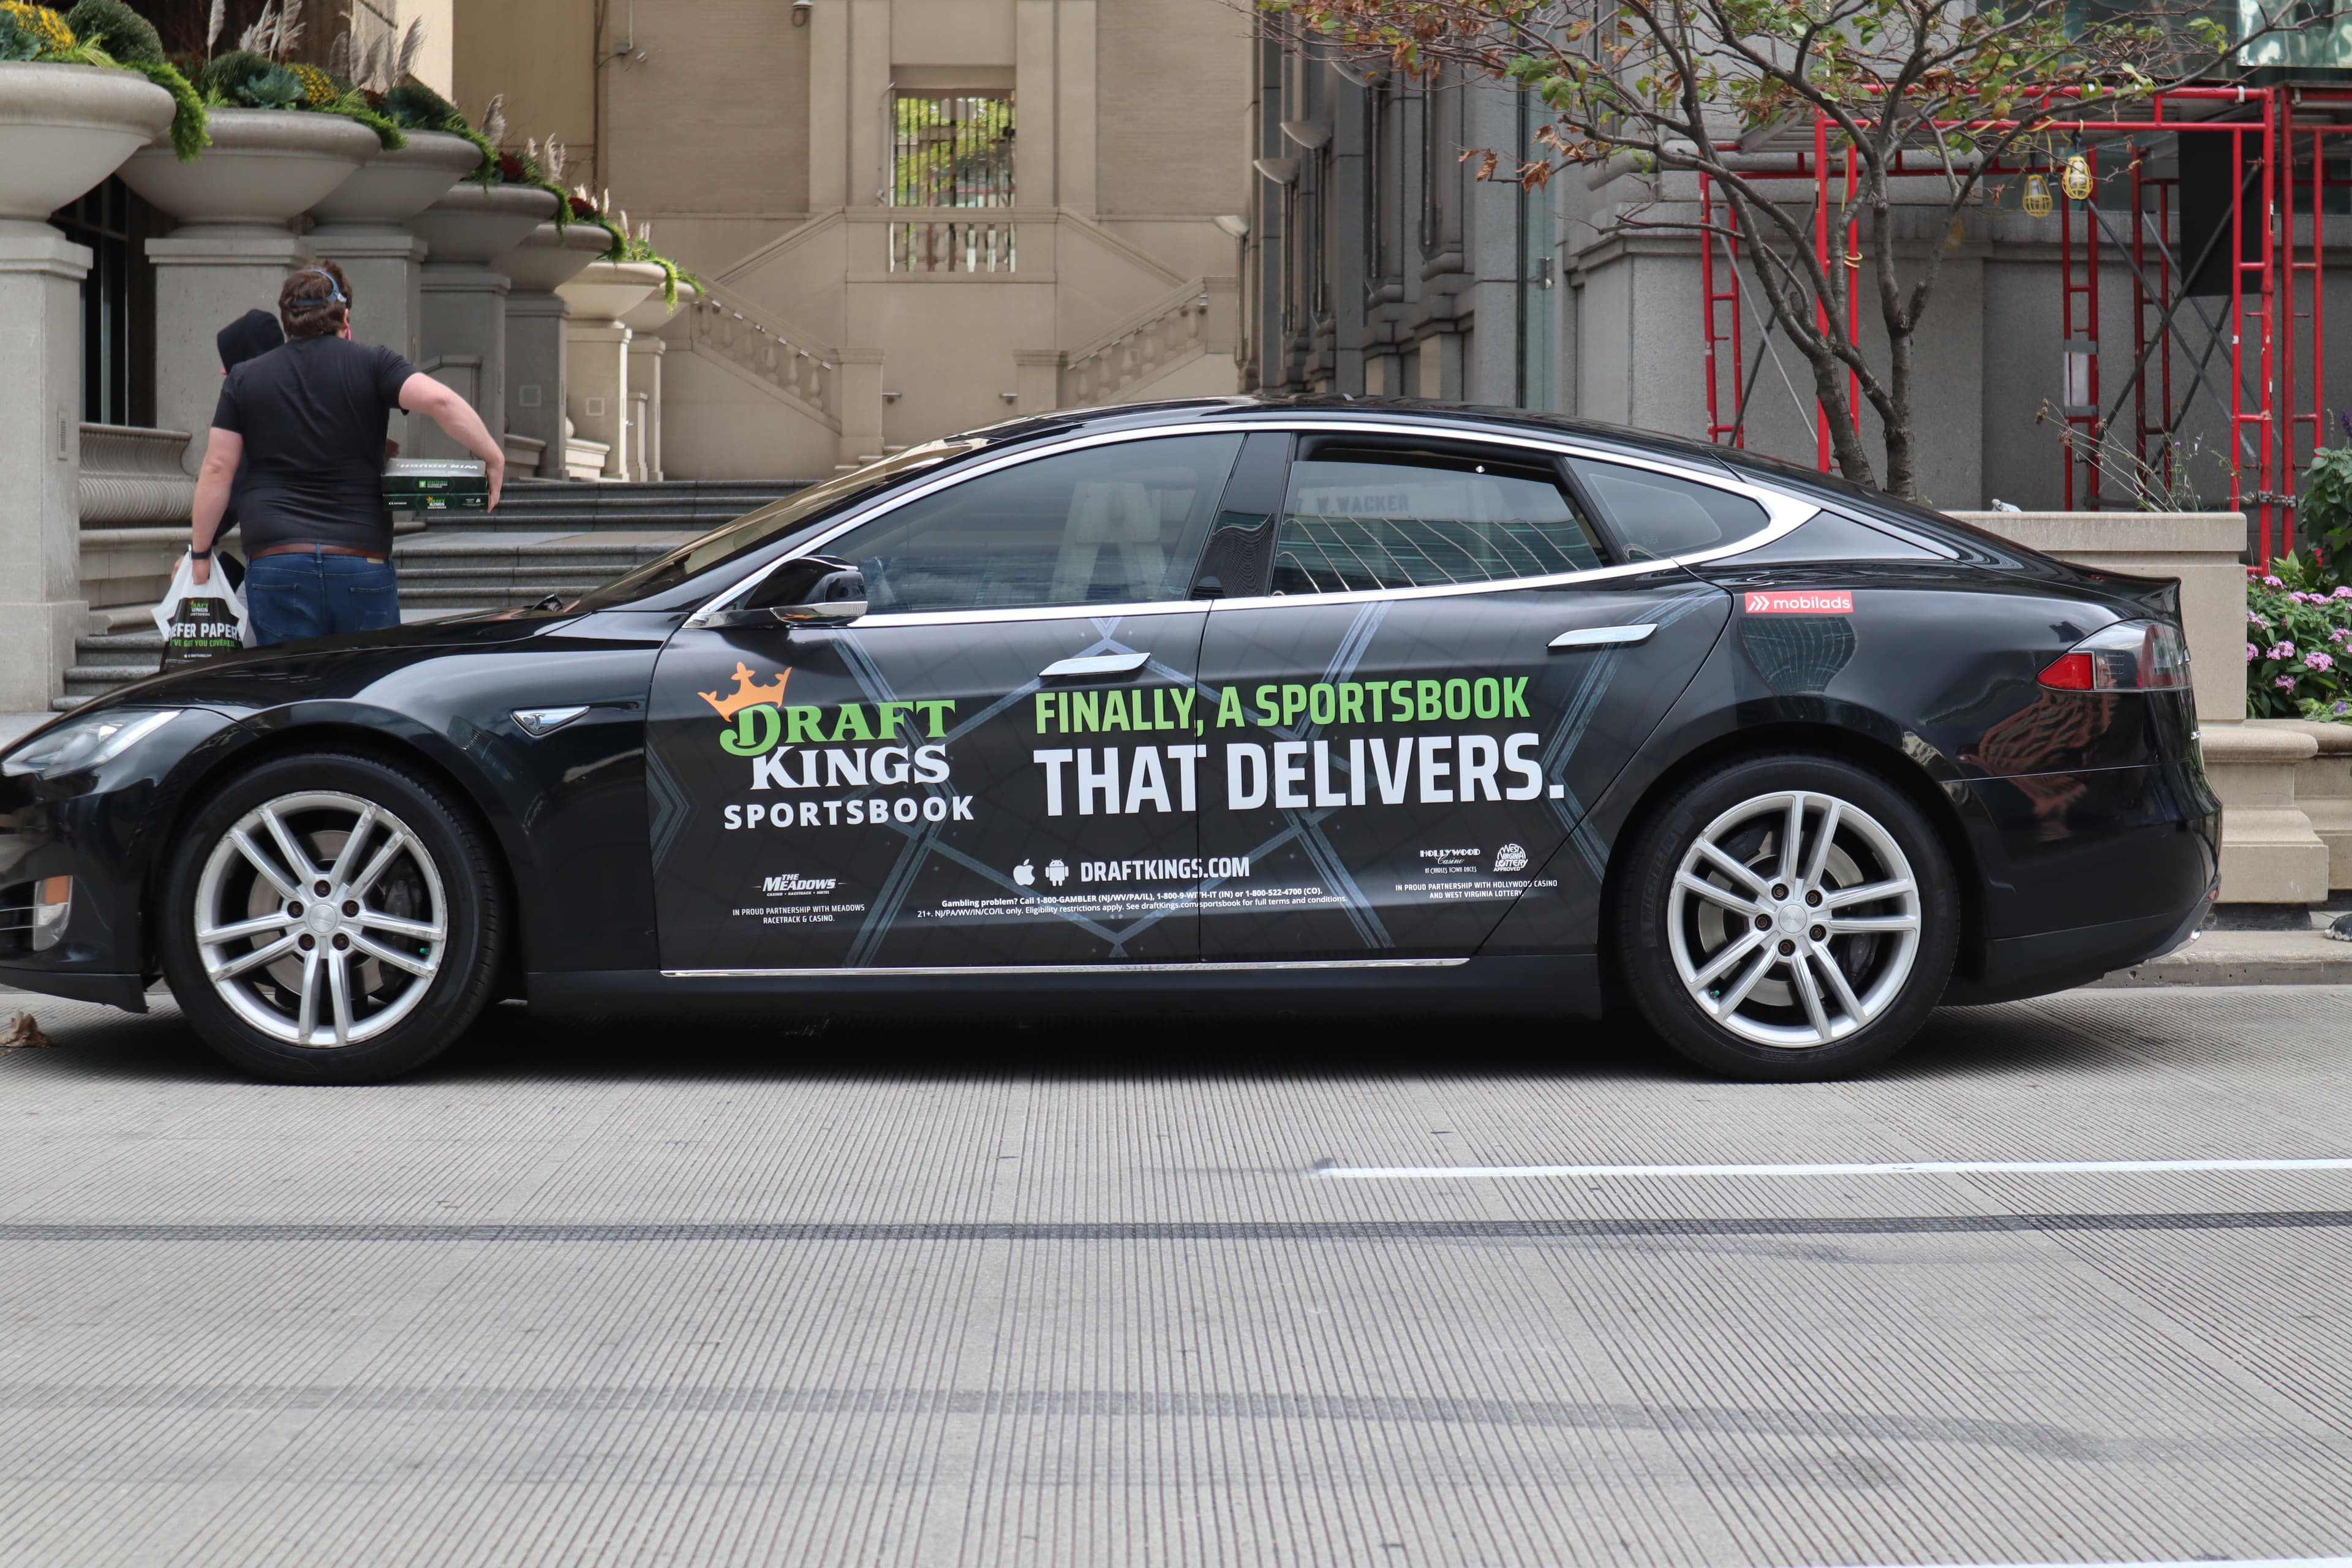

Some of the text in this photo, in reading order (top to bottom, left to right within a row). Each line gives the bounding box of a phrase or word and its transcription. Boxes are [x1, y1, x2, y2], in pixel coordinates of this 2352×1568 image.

[1773, 596, 1851, 609] mobilads
[1035, 676, 1531, 737] FINALLY, A SPORTSBOOK
[719, 699, 956, 756] DRAFT
[750, 744, 950, 790] KINGS
[1033, 732, 1565, 816] THAT DELIVERS.
[723, 796, 974, 830] SPORTSBOOK
[1420, 848, 1480, 858] HOLLYWOOD
[1434, 856, 1464, 865] Casino
[1080, 857, 1250, 883] DRAFTKINGS.COM
[1495, 859, 1528, 869] LOTTERY
[762, 876, 836, 892] MEADOWS
[941, 899, 980, 908] Gambling
[981, 898, 1017, 907] problem?
[1036, 895, 1097, 904] 1-800-GAMBLER
[1098, 893, 1155, 903] (NJ/WV/PA/IL),
[1245, 888, 1302, 897] 1-800-522-4700
[766, 906, 811, 914] PARTNERSHIP
[831, 903, 865, 912] MEADOWS
[935, 908, 1004, 918] NJ/PA/WV/IN/CO/IL
[1006, 907, 1023, 916] only.
[1025, 906, 1058, 915] Eligibility
[1102, 903, 1124, 912] apply.
[763, 916, 801, 924] RACETRACK
